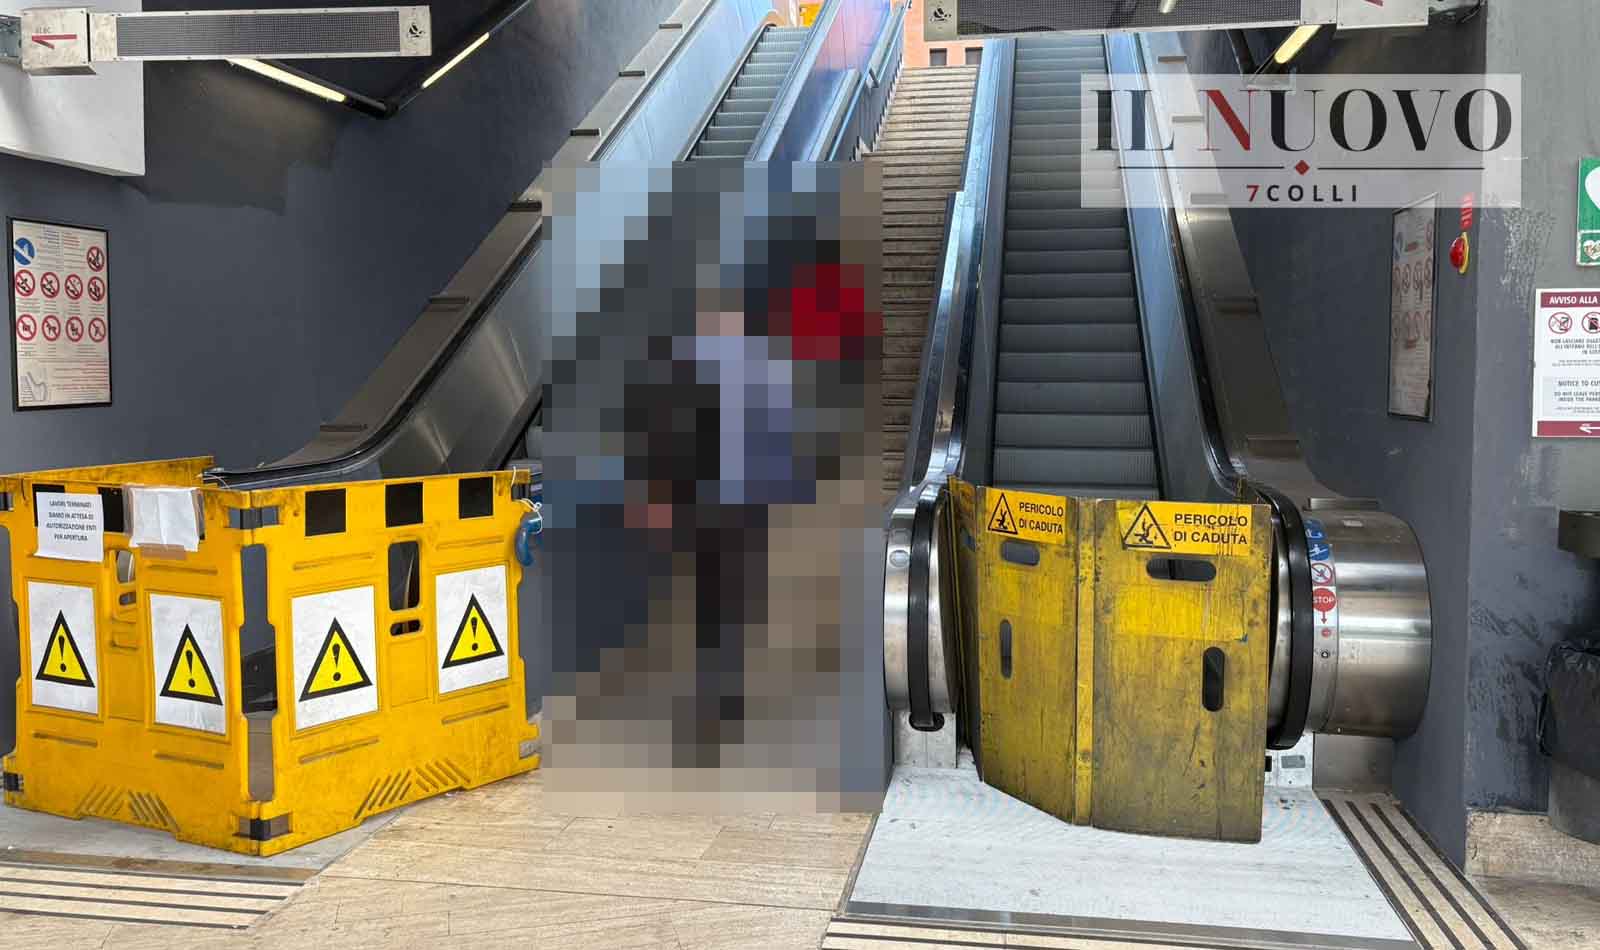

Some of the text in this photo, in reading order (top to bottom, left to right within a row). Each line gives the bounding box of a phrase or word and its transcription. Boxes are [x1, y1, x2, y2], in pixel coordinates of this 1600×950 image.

[1549, 295, 1598, 305] AVVISO ALLA
[1019, 502, 1064, 517] PERICOLO
[1019, 518, 1063, 535] DI CADUTA
[1174, 513, 1248, 527] PERICOLO
[1174, 531, 1248, 545] DI CADUTA
[1313, 596, 1335, 604] STOP
